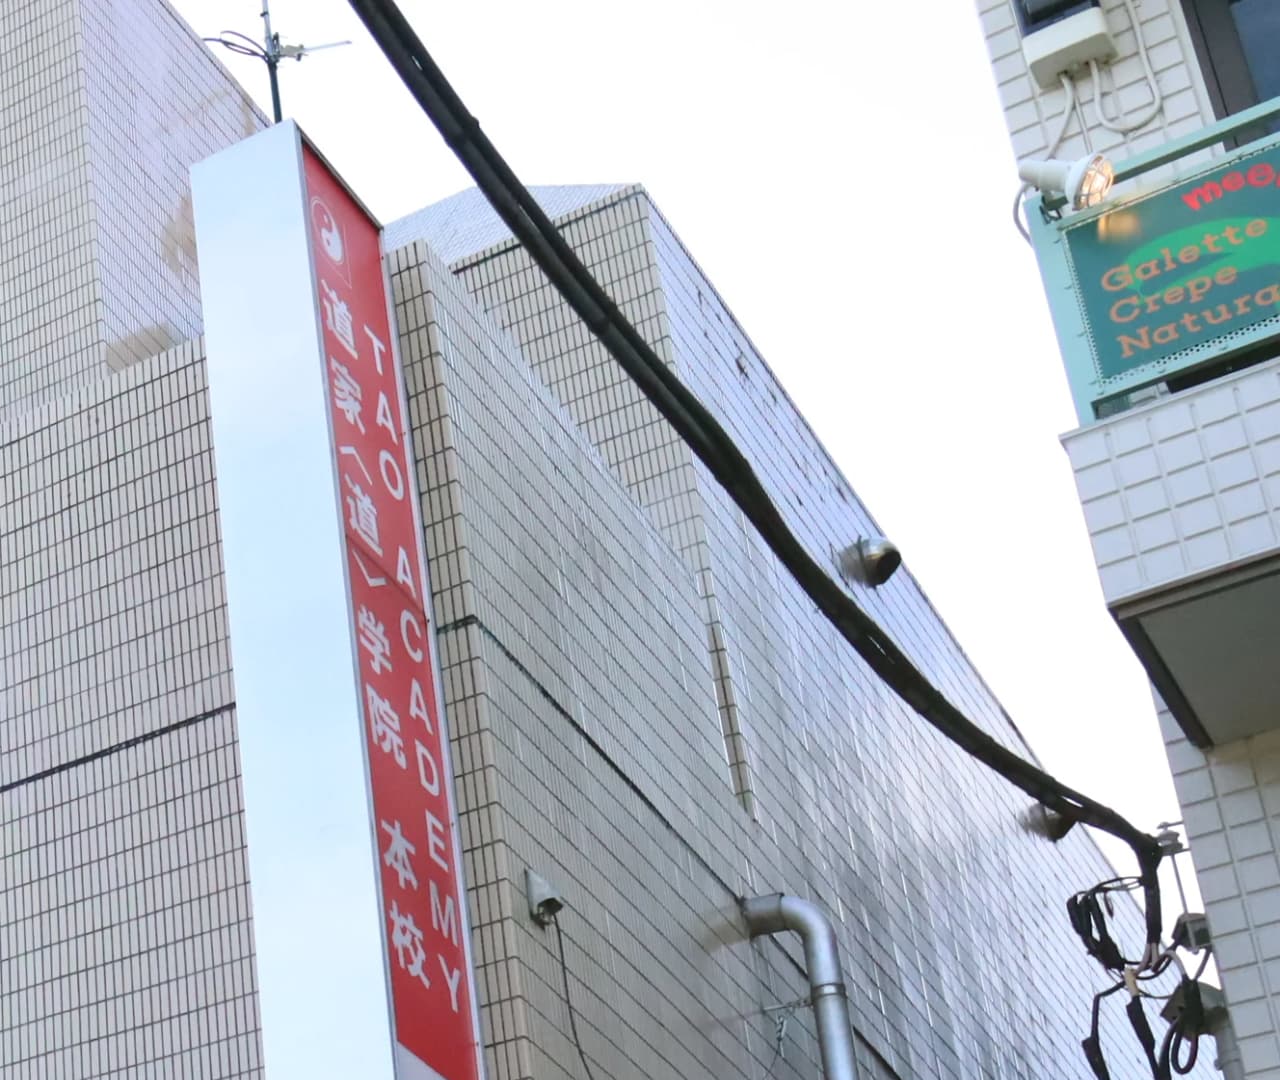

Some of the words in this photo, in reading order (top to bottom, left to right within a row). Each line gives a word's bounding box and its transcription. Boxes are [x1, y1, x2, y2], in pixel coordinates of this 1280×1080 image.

[1182, 163, 1280, 211] mee
[1101, 219, 1268, 291] Galette
[1109, 266, 1237, 323] Crepe
[364, 324, 403, 500] TAO
[396, 546, 461, 1014] ACADEMY
[381, 819, 431, 990] 本校
